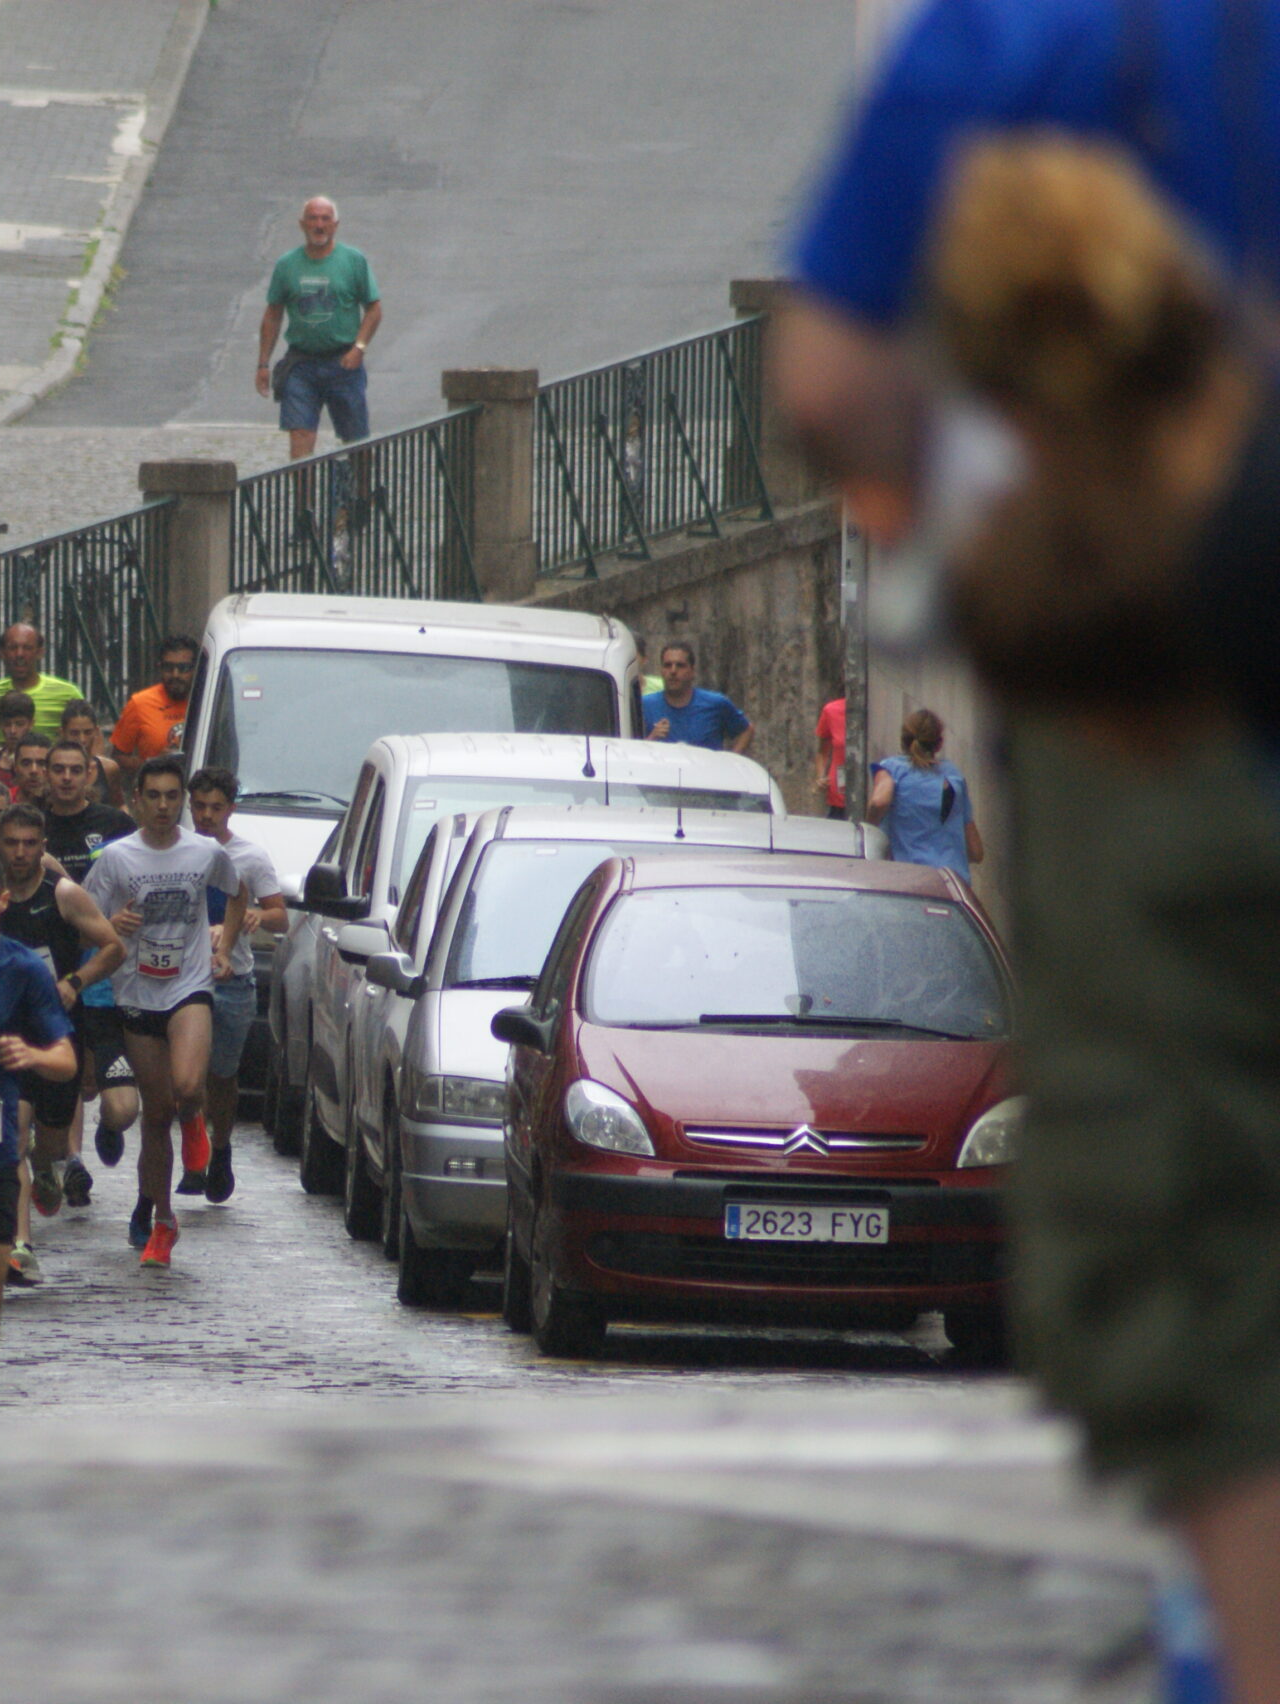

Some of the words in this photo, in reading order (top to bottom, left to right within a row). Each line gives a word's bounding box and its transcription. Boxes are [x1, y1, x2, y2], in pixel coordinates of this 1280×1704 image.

[150, 953, 171, 968] 35
[745, 1210, 813, 1236] 2623
[830, 1212, 882, 1238] FYG
